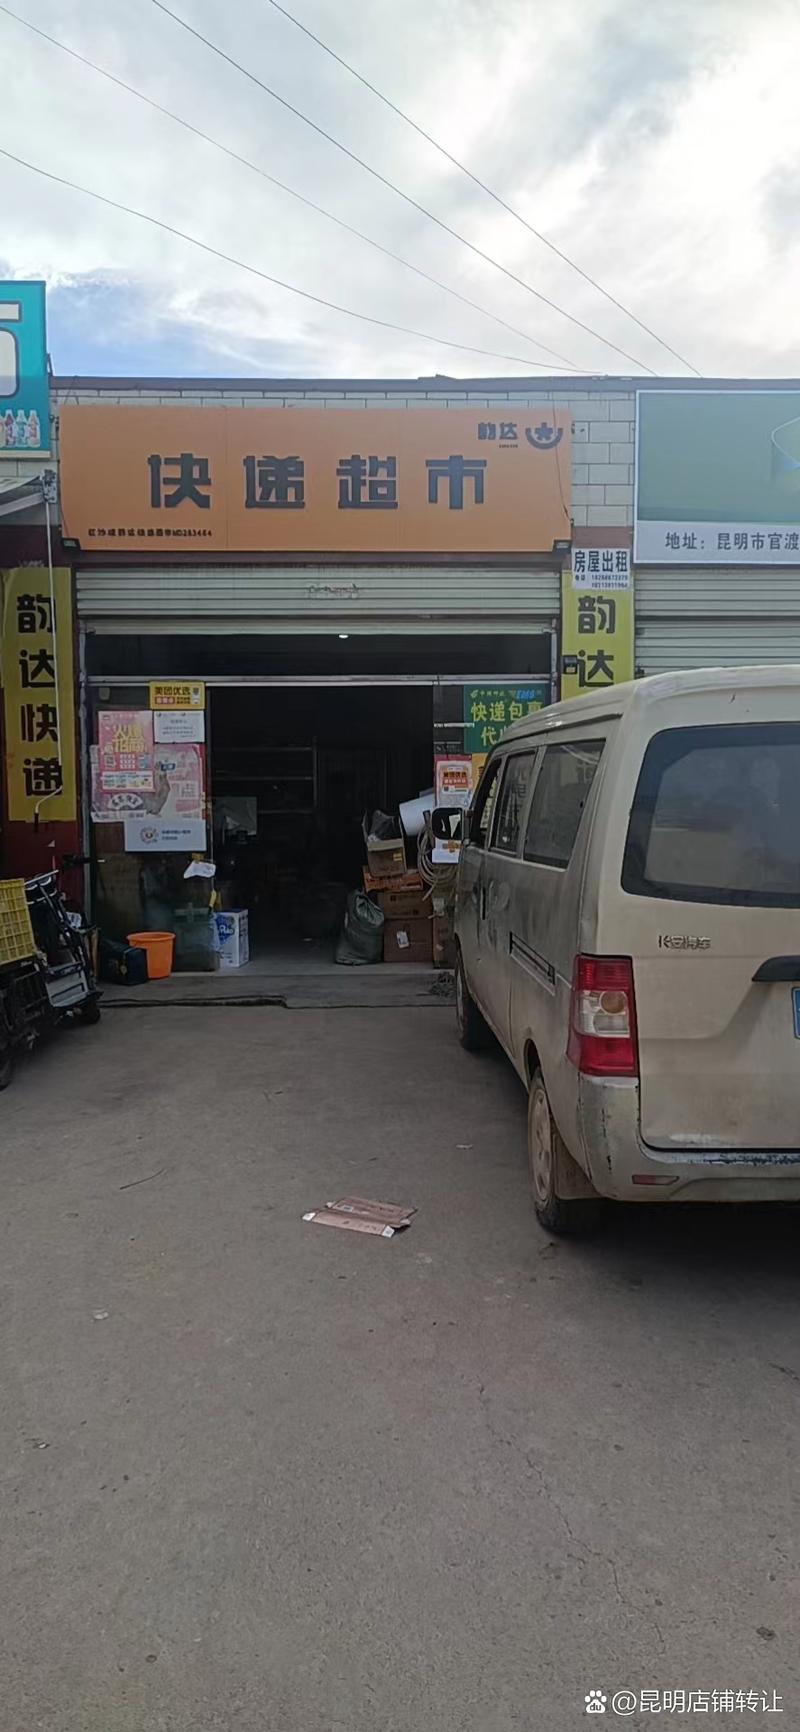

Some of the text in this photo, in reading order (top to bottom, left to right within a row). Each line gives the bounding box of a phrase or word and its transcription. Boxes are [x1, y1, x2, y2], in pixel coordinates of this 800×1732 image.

[148, 453, 487, 510] 快递超市
[574, 550, 628, 573] 房屋出租
[578, 596, 616, 688] 韵达
[17, 594, 62, 796] 韵达快递
